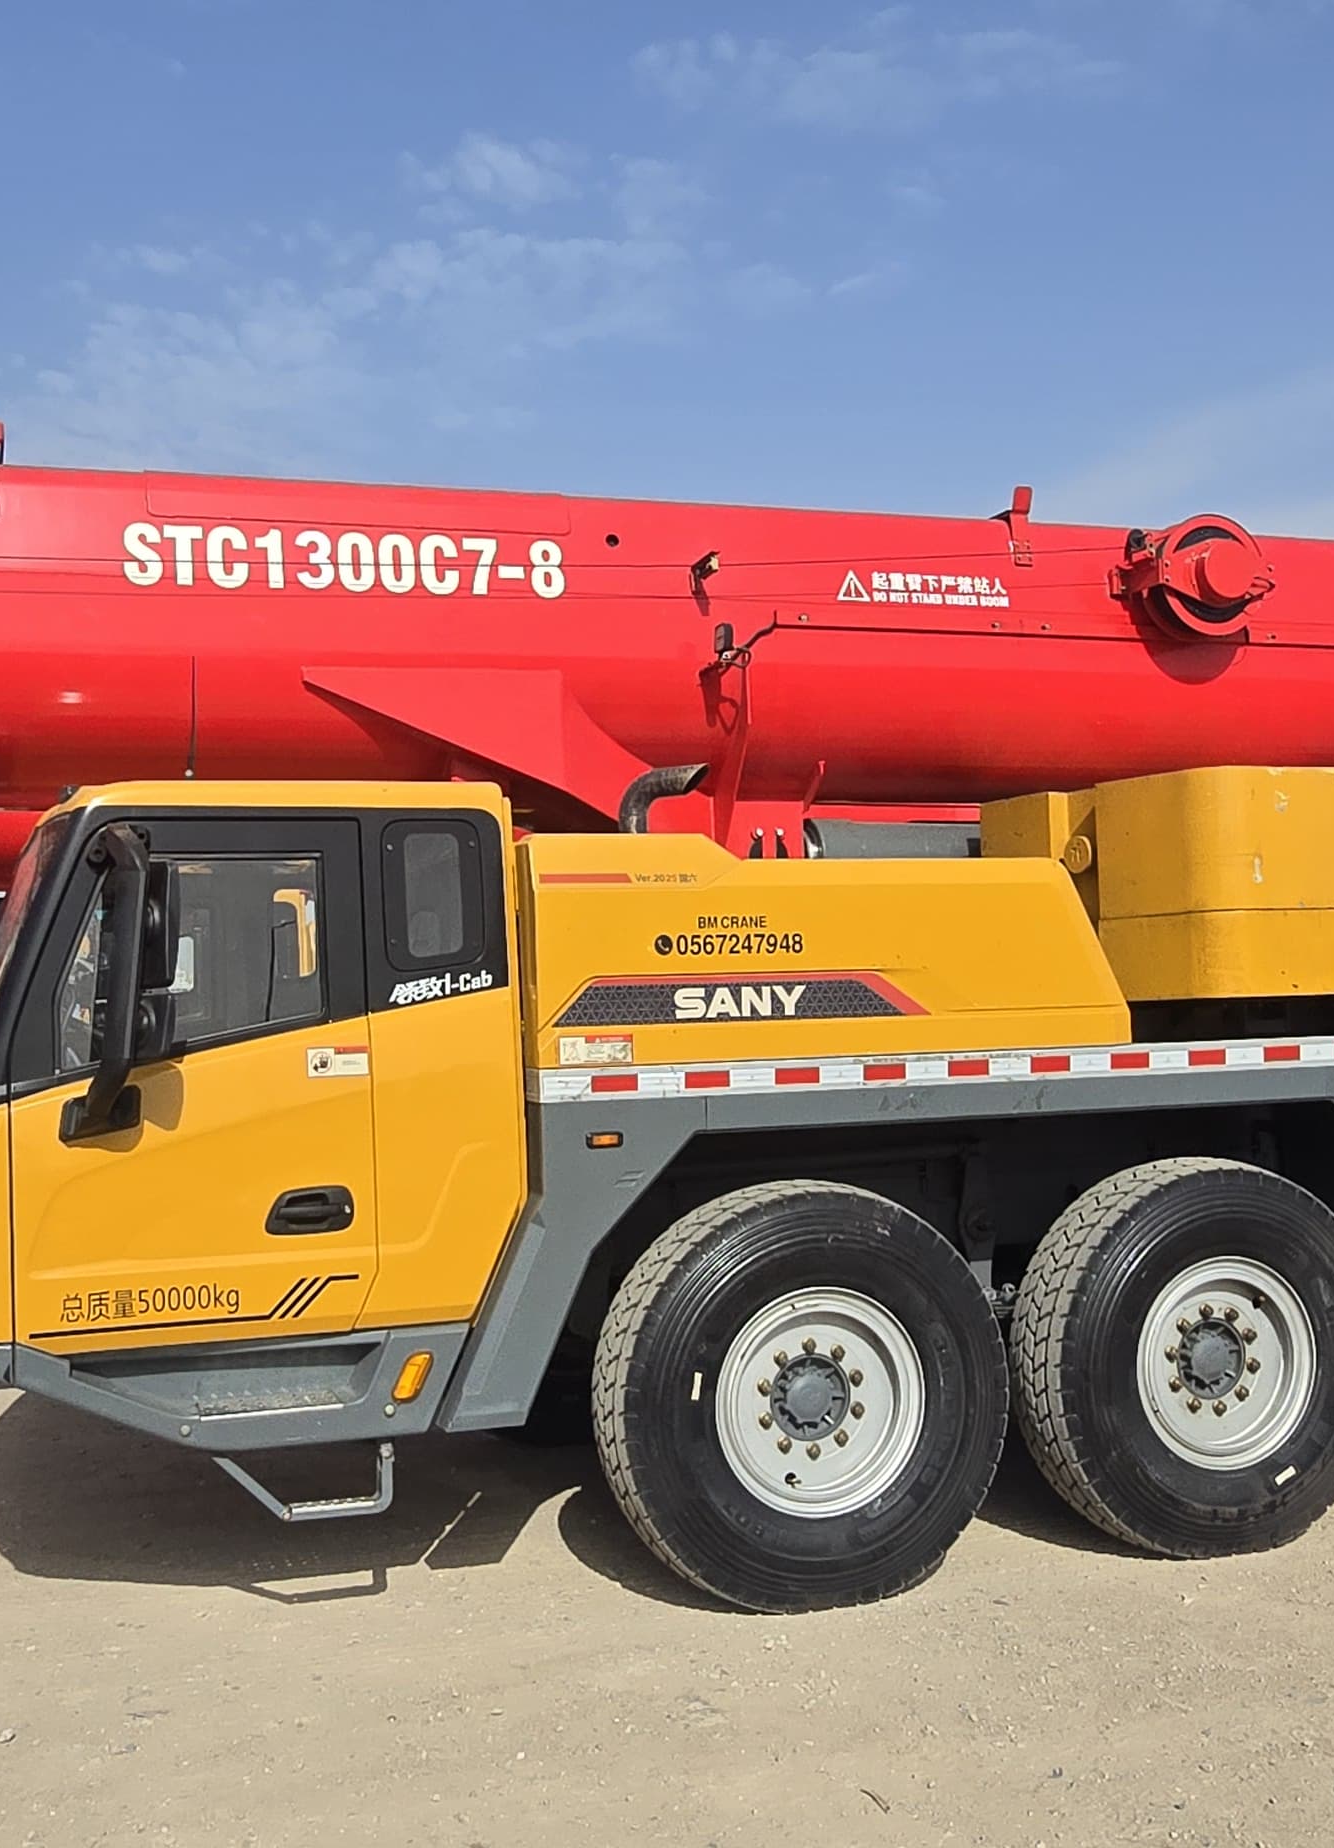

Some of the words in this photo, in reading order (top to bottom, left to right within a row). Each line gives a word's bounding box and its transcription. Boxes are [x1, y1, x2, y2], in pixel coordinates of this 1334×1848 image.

[121, 521, 566, 600] STC1300C7-8
[872, 591, 887, 603] DO
[889, 592, 909, 604] NOT
[911, 593, 943, 605] STAND
[944, 594, 978, 606] UNDER
[980, 596, 1010, 608] BOOM
[697, 916, 718, 929] BM
[720, 915, 767, 929] CRANE
[676, 933, 804, 956] 0567247948
[673, 985, 807, 1020] SANY
[60, 1283, 240, 1323] 总质量50000kg
